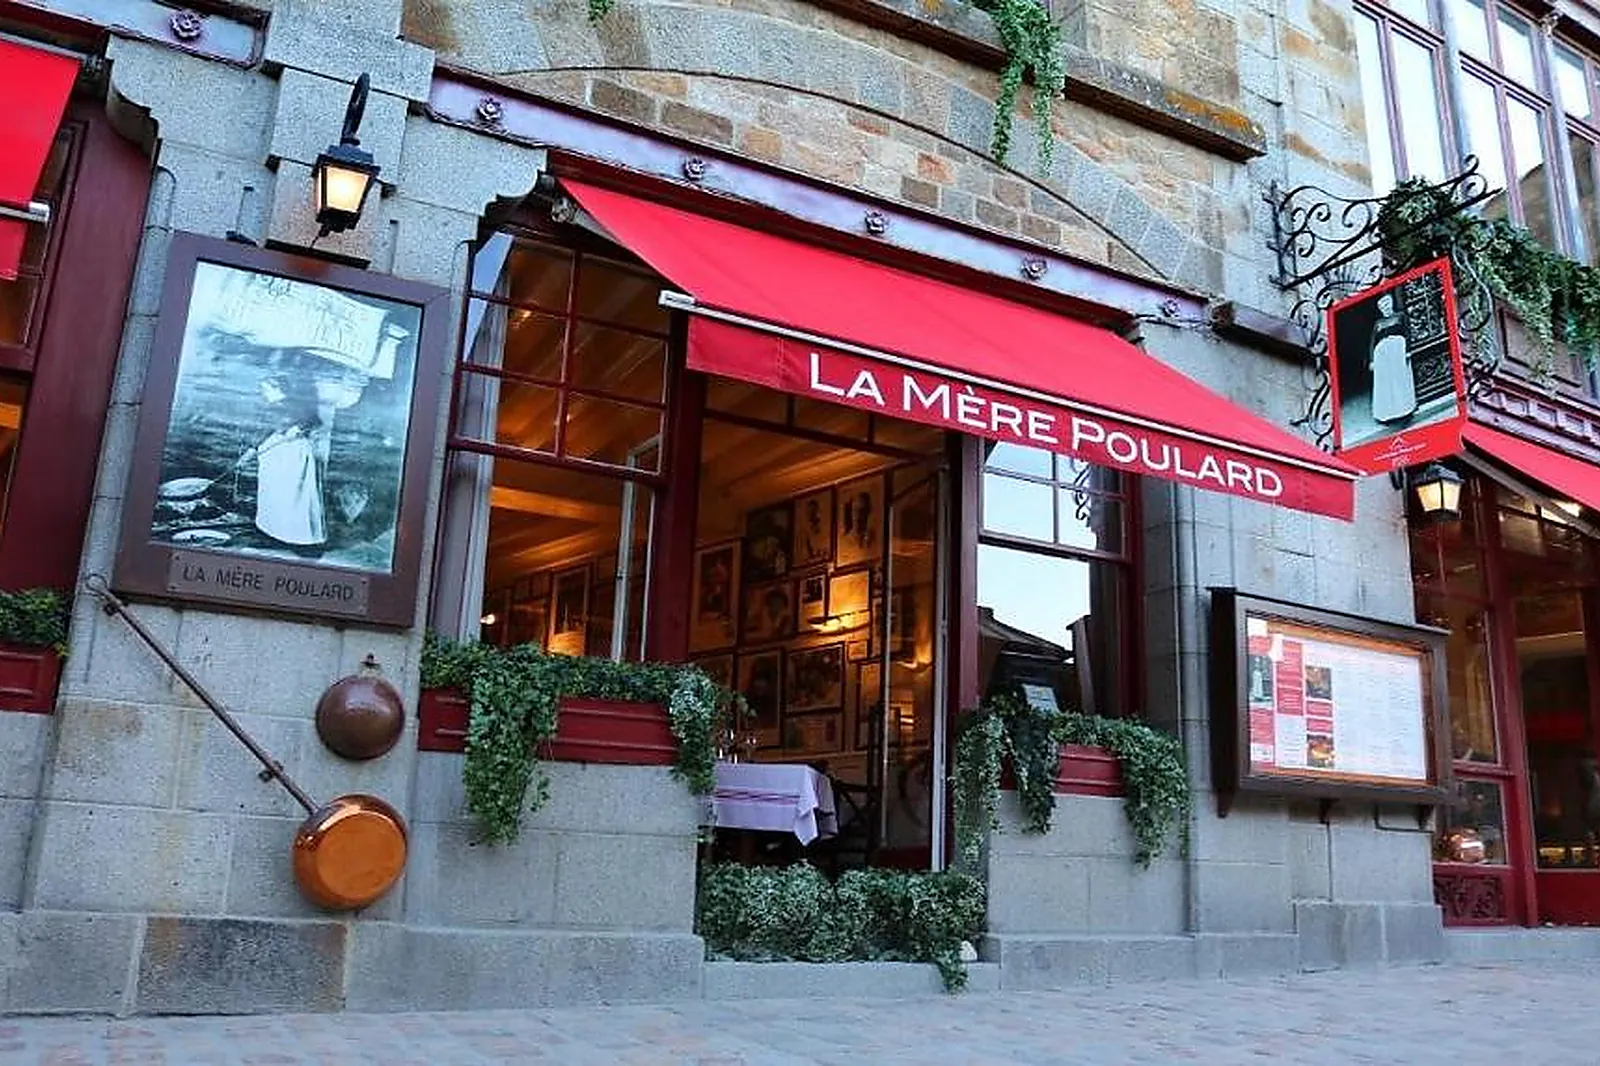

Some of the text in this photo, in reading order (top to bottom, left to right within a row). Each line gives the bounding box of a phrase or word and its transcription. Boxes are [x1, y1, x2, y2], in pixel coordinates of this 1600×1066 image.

[809, 352, 1283, 497] LA MÈRE POULARD
[183, 565, 354, 601] LA MÈRE POULARD
